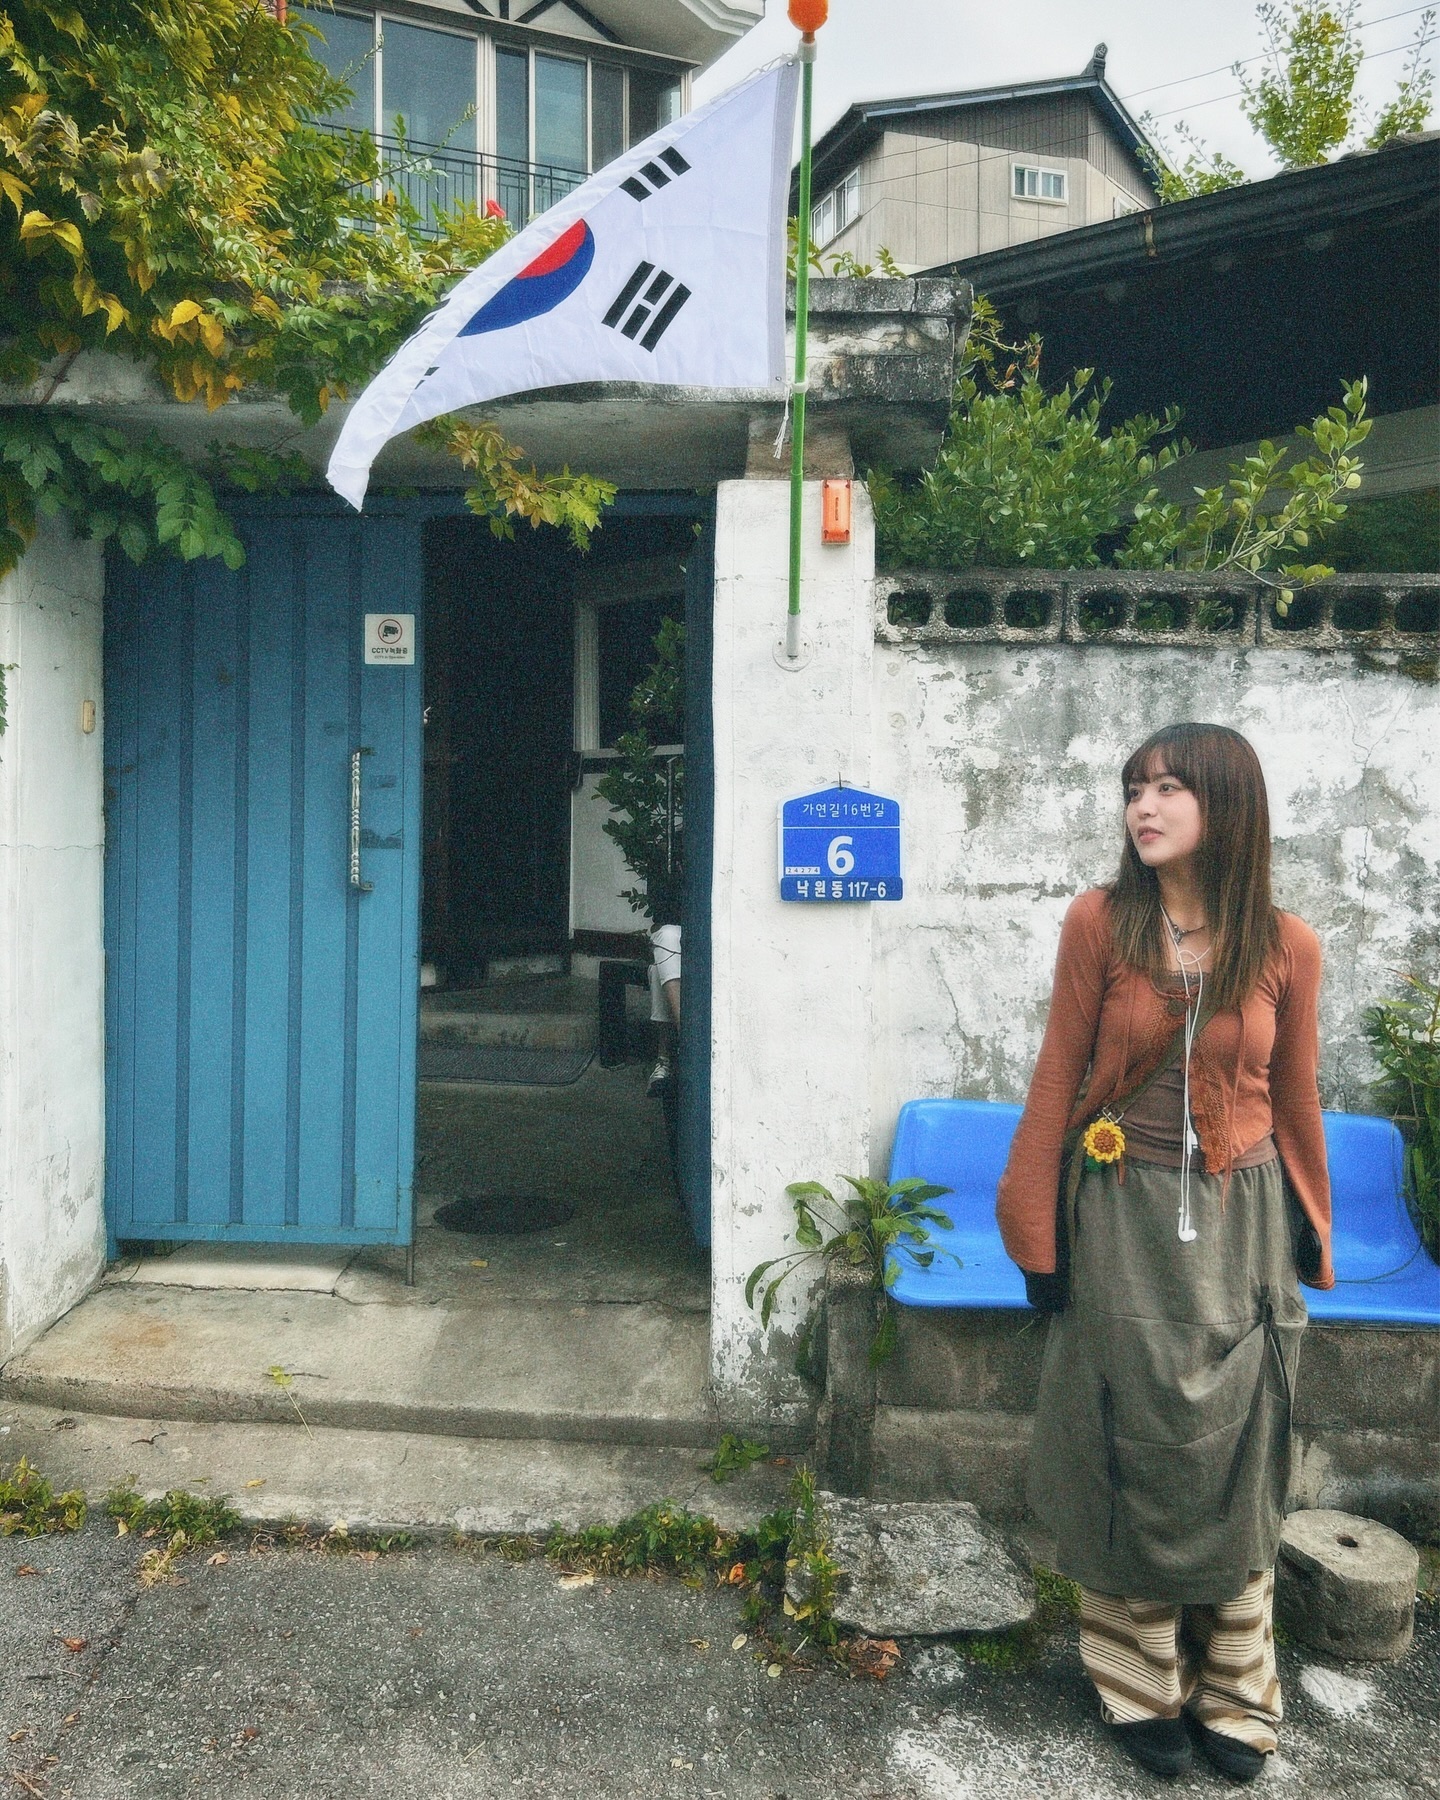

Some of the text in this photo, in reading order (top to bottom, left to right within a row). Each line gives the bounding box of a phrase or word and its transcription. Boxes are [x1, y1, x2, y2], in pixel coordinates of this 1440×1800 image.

[802, 803, 885, 818] 가연길16번길
[827, 835, 855, 876] 6
[797, 880, 887, 898] 낙원동 117-6
